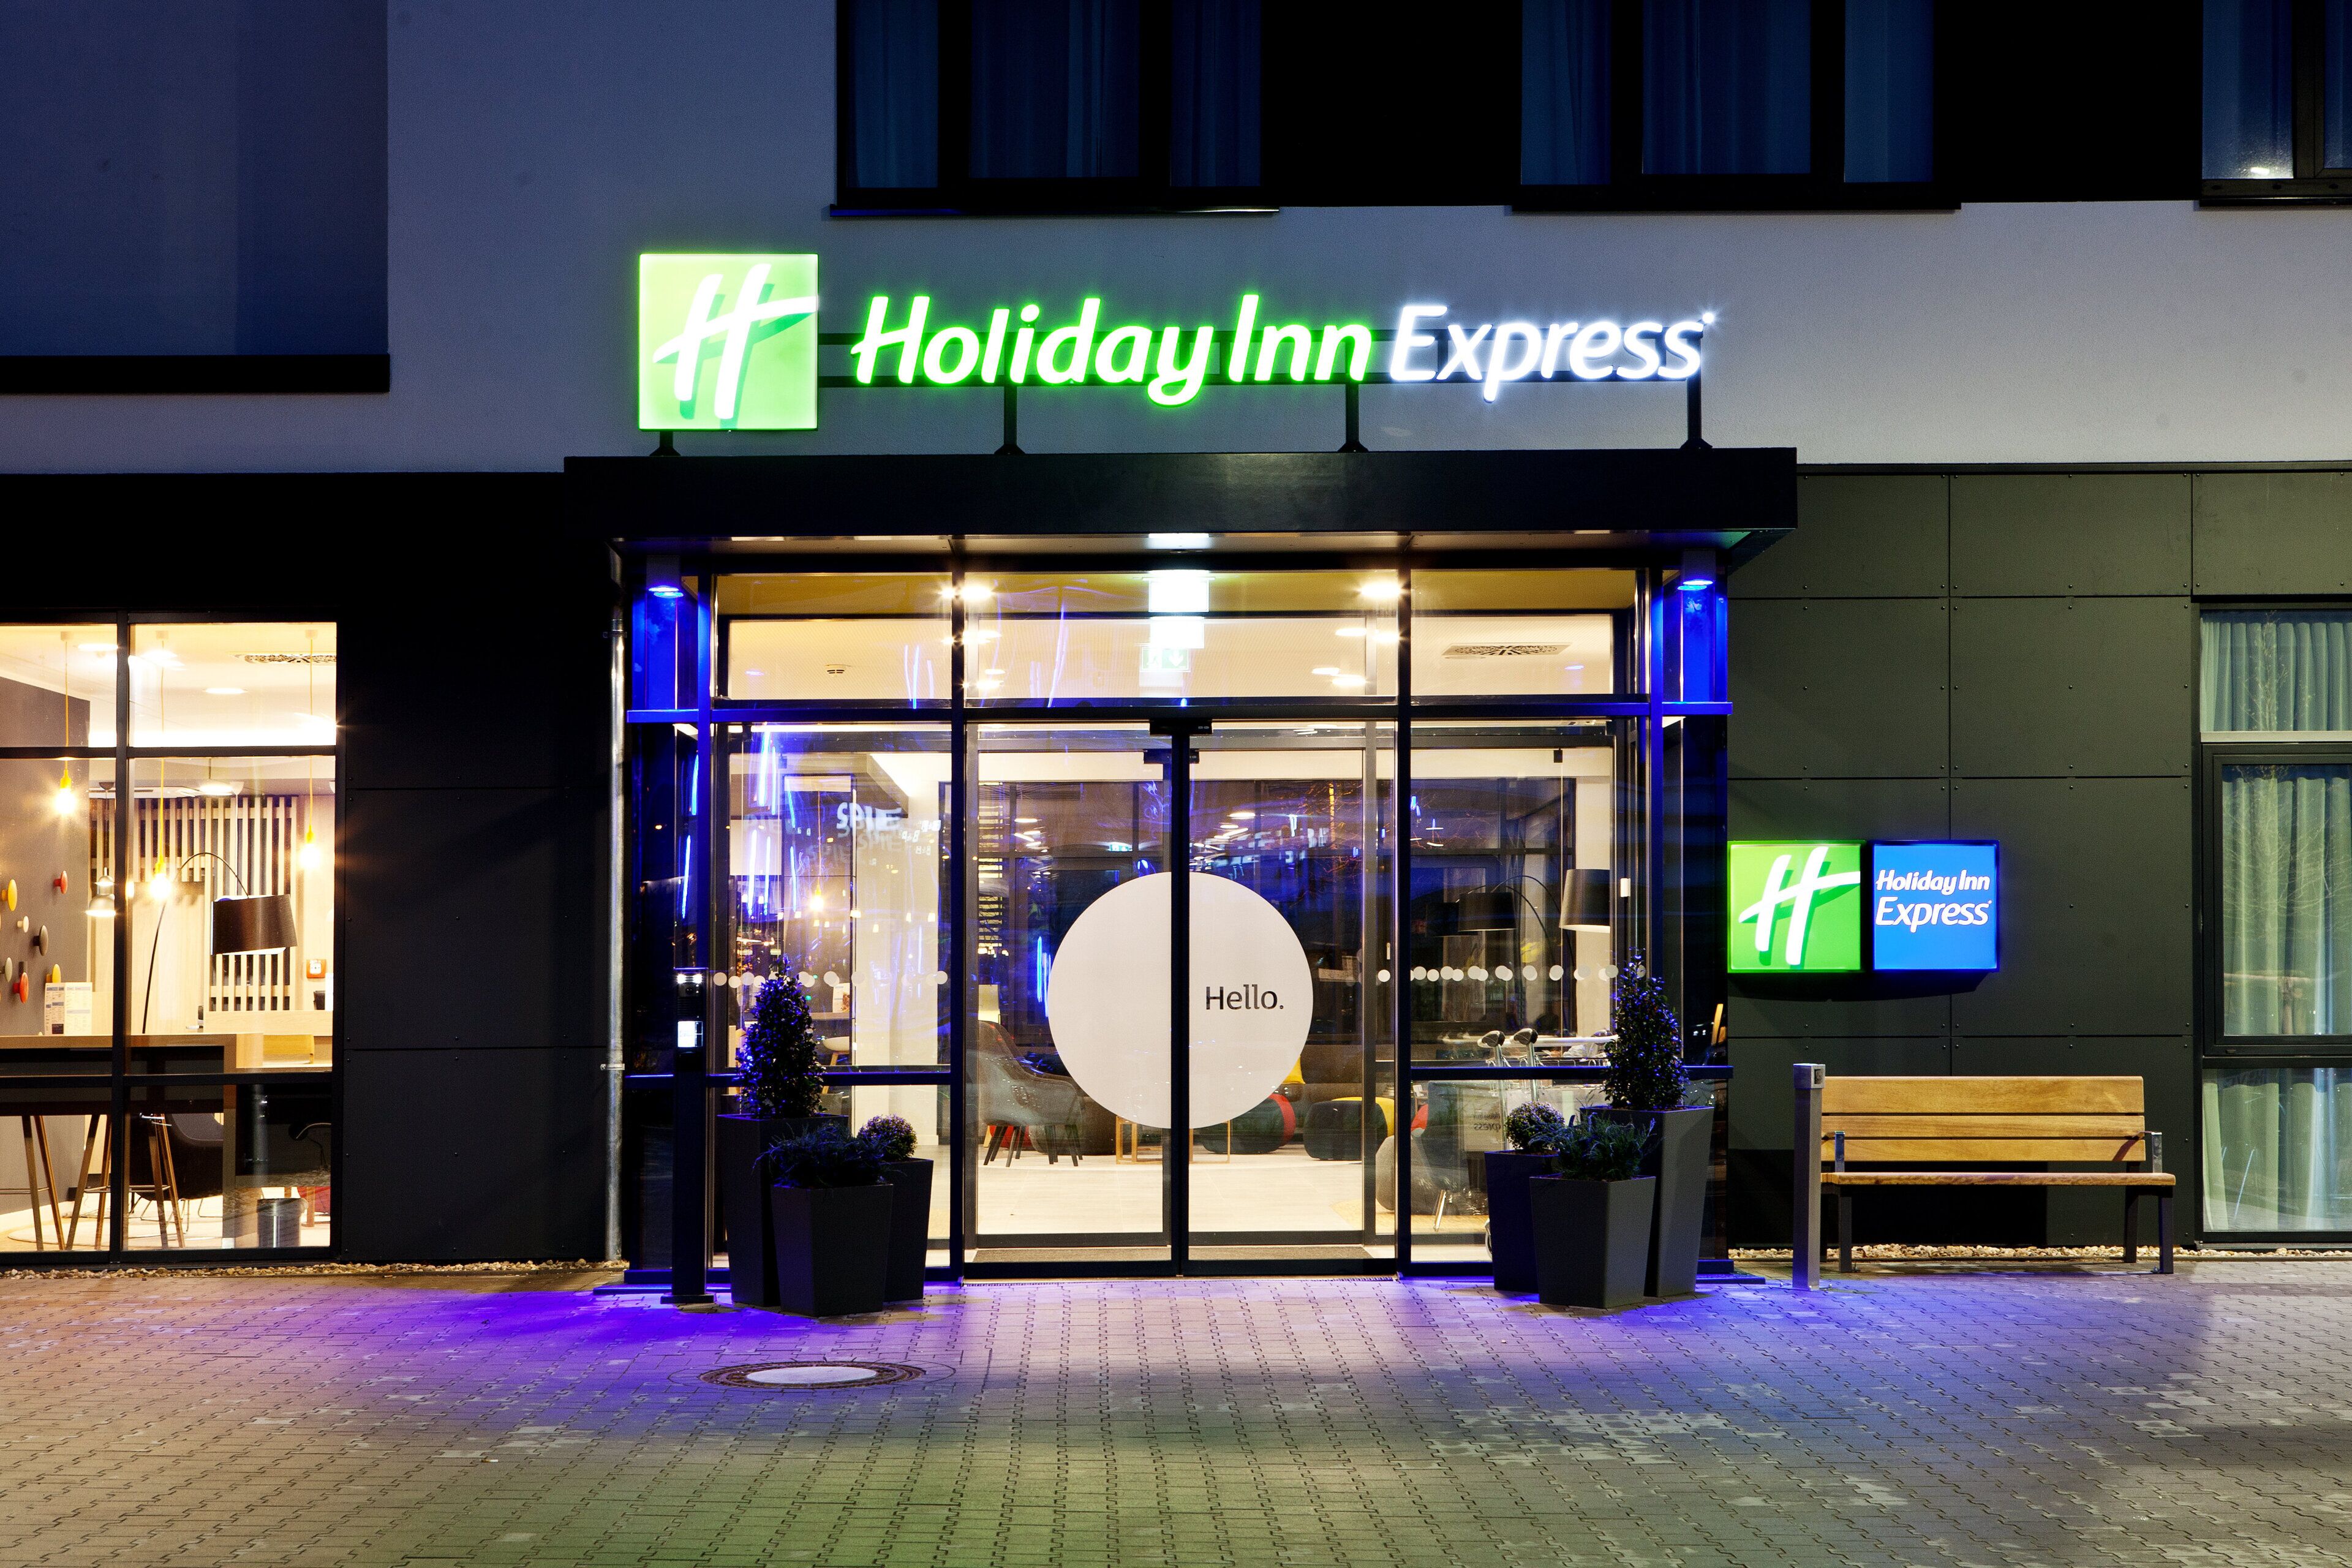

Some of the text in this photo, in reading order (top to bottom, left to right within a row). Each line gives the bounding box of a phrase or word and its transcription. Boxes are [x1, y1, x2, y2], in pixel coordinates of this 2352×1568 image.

[851, 295, 1704, 405] Holiday Inn Express
[1875, 869, 1991, 895] Holiday Inn
[1875, 896, 1989, 933] Express
[1206, 984, 1284, 1010] Hello.
